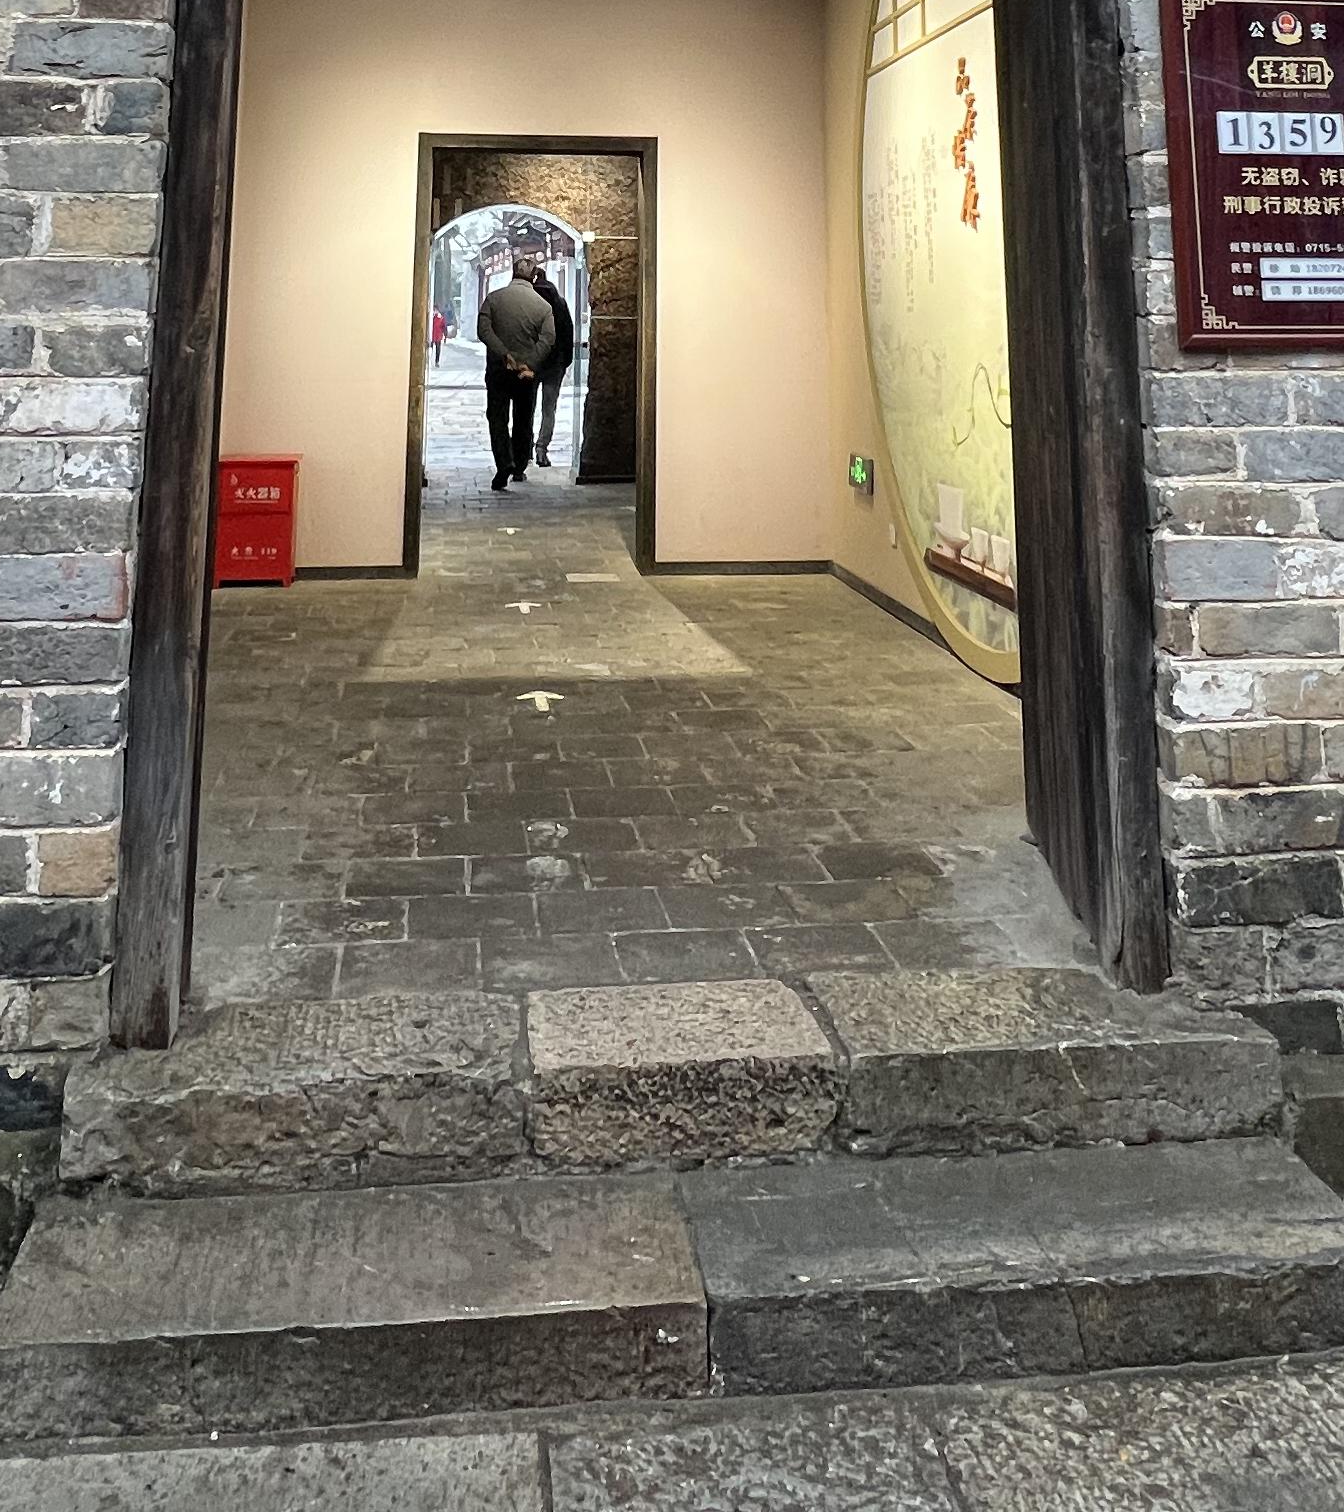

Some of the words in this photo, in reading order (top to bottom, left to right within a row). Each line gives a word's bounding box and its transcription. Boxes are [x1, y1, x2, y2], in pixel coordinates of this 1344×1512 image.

[1249, 21, 1265, 38] 公
[1310, 22, 1327, 40] 安
[1227, 117, 1337, 150] 1359
